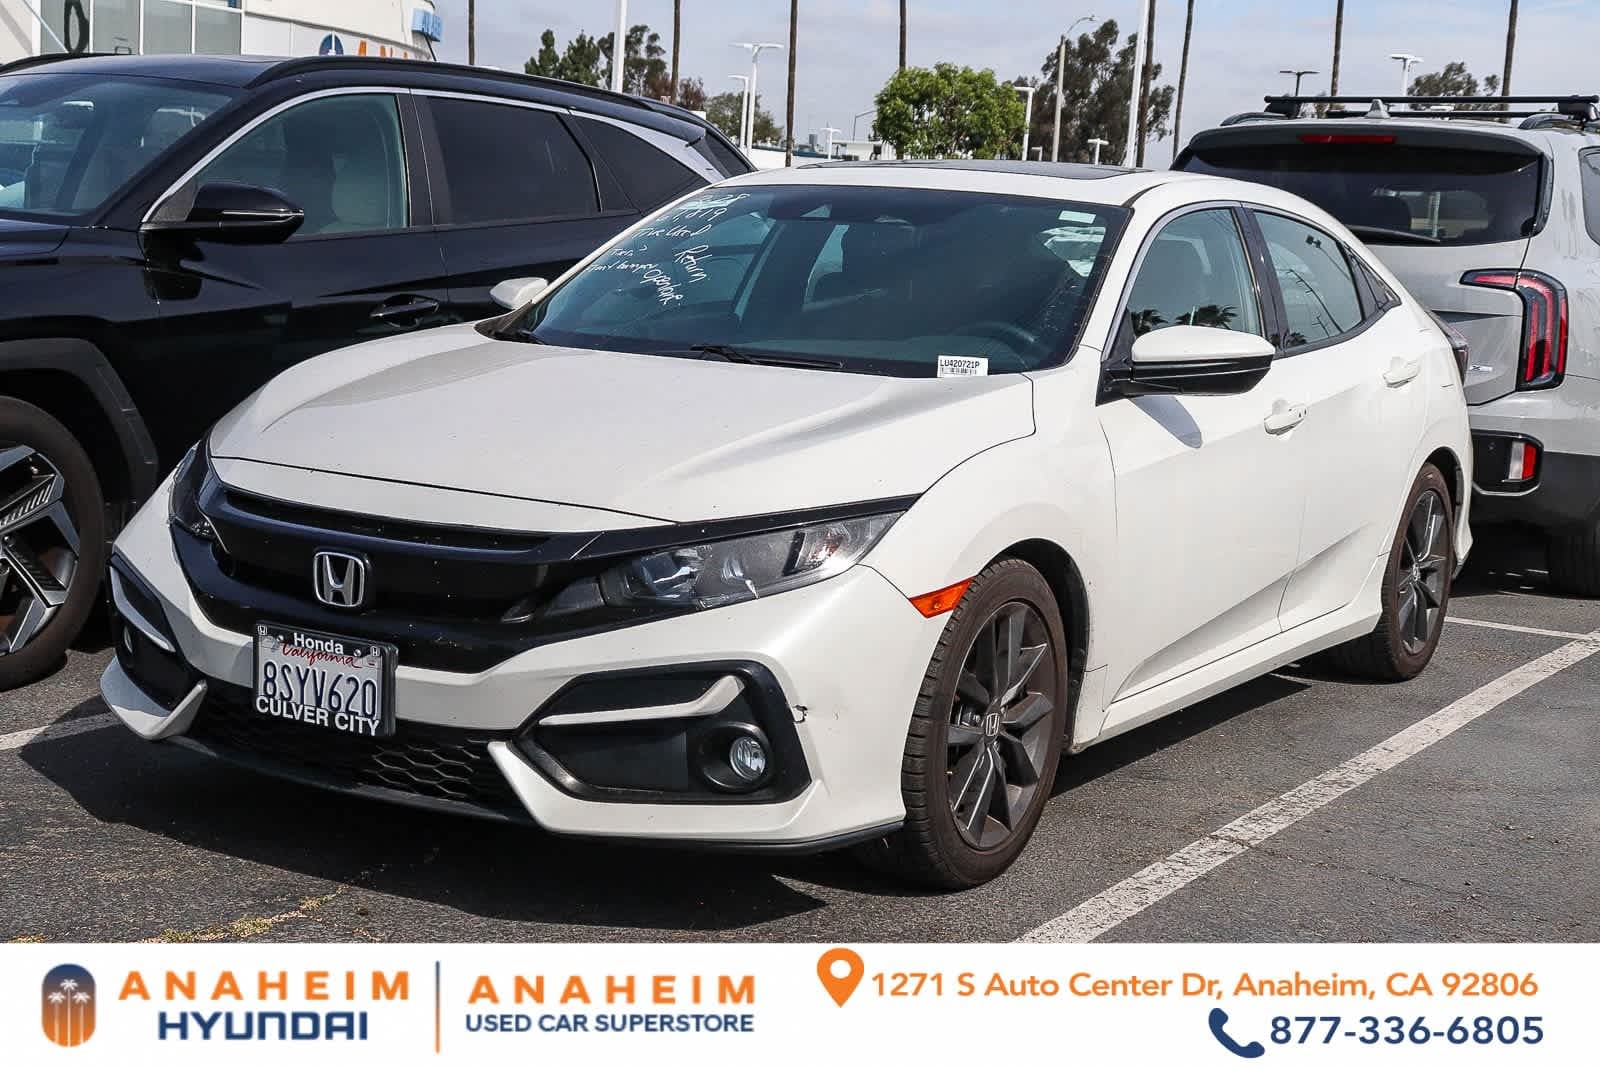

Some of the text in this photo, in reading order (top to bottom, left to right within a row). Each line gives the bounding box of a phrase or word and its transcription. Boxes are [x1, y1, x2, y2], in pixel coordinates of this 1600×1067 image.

[940, 359, 980, 369] LU420721P
[293, 632, 344, 655] Honda
[263, 661, 378, 719] 8SYV620
[255, 695, 380, 737] CULVER CITY
